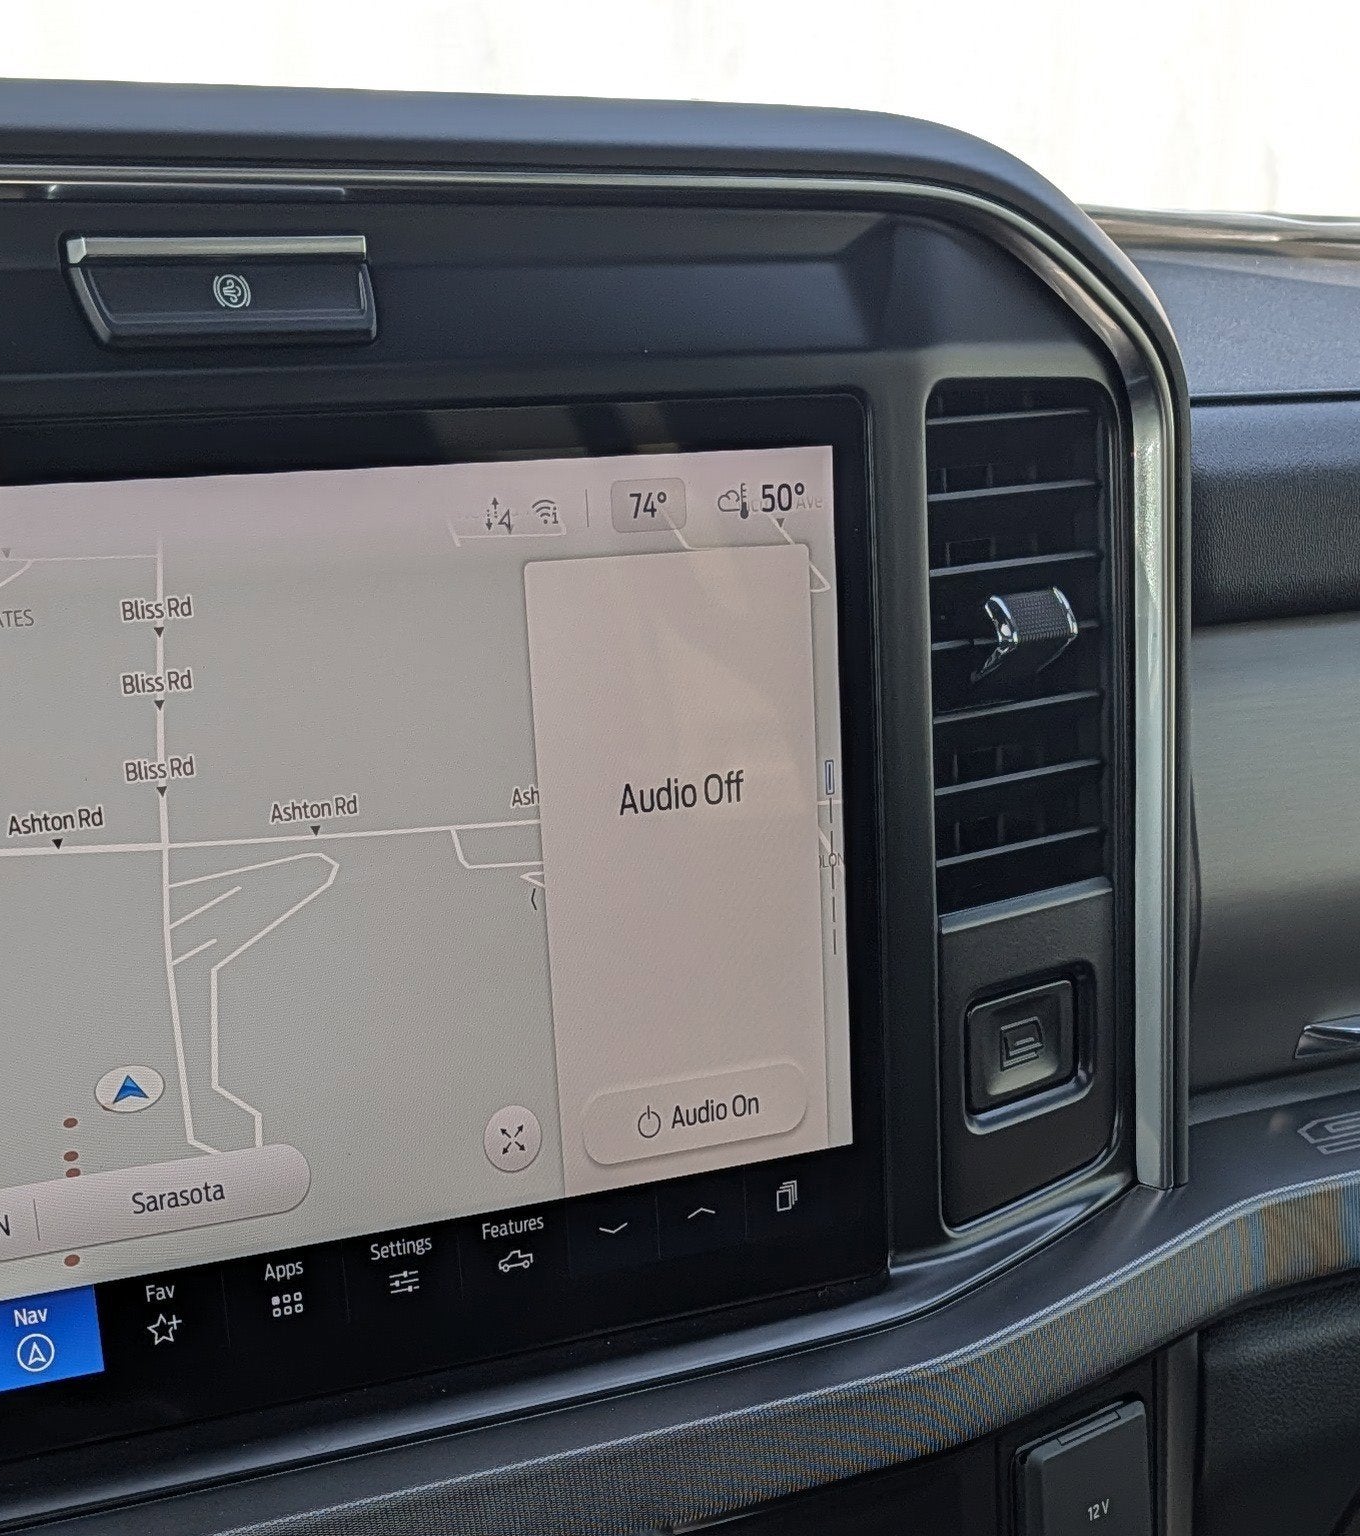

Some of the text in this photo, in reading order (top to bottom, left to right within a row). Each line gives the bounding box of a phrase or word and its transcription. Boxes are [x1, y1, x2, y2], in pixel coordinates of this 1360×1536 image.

[121, 597, 193, 621] Bliss Rd
[122, 670, 193, 695] Bliss Rd
[125, 757, 194, 782] Bliss Rd
[620, 770, 744, 816] Audio Off
[271, 795, 358, 823] Ashton Rd
[8, 807, 103, 838] Ashton Rd
[671, 1094, 760, 1130] Audio On
[132, 1180, 225, 1214] Sarasota
[482, 1213, 544, 1239] Features
[370, 1233, 432, 1261] Settings
[264, 1258, 304, 1283] Apps
[145, 1283, 174, 1302] Fav
[14, 1306, 48, 1327] Nav
